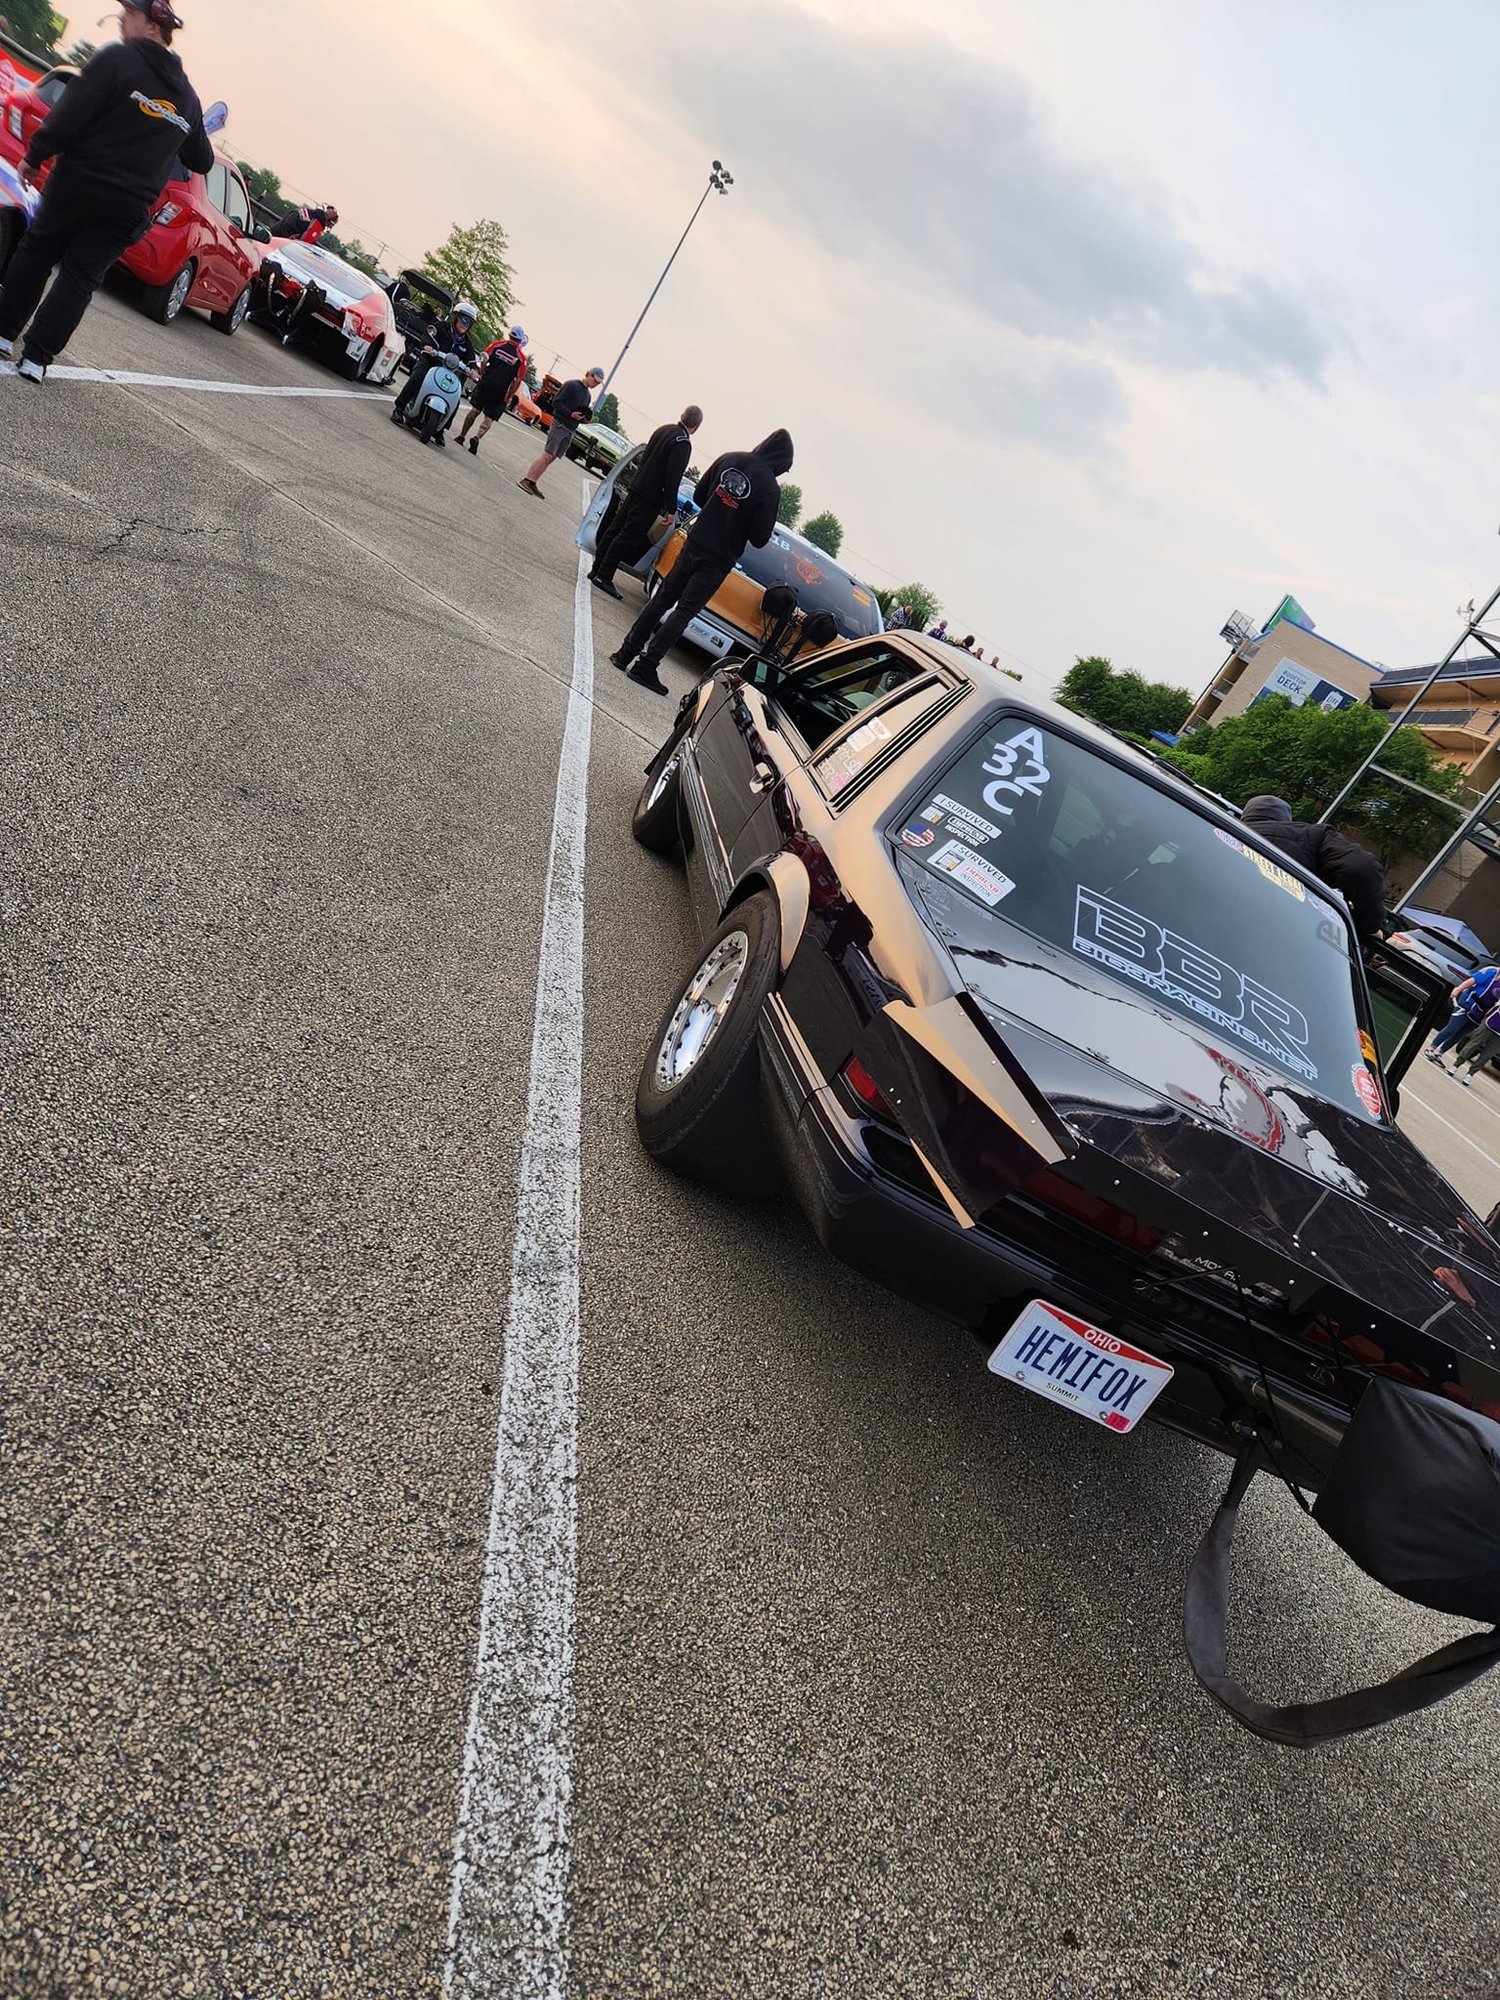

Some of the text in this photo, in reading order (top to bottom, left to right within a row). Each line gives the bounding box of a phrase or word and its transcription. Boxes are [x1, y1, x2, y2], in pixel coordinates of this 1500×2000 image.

[1277, 675, 1303, 694] DECK
[1283, 671, 1307, 686] ROOFTOP
[1004, 727, 1044, 765] A
[982, 743, 1050, 796] 32
[983, 780, 1024, 816] C
[946, 801, 994, 833] SURVIVED
[945, 824, 980, 847] INSPECTION
[951, 818, 986, 842] IMPOUND
[959, 848, 1007, 884] SURVIVED
[960, 872, 992, 897] INSPECTION
[965, 866, 1000, 893] IMPOUND
[1195, 1257, 1241, 1281] MOA
[1083, 1329, 1121, 1353] OHIO
[1014, 1325, 1148, 1412] HEMIFOX
[1046, 1382, 1079, 1401] SUMMIT
